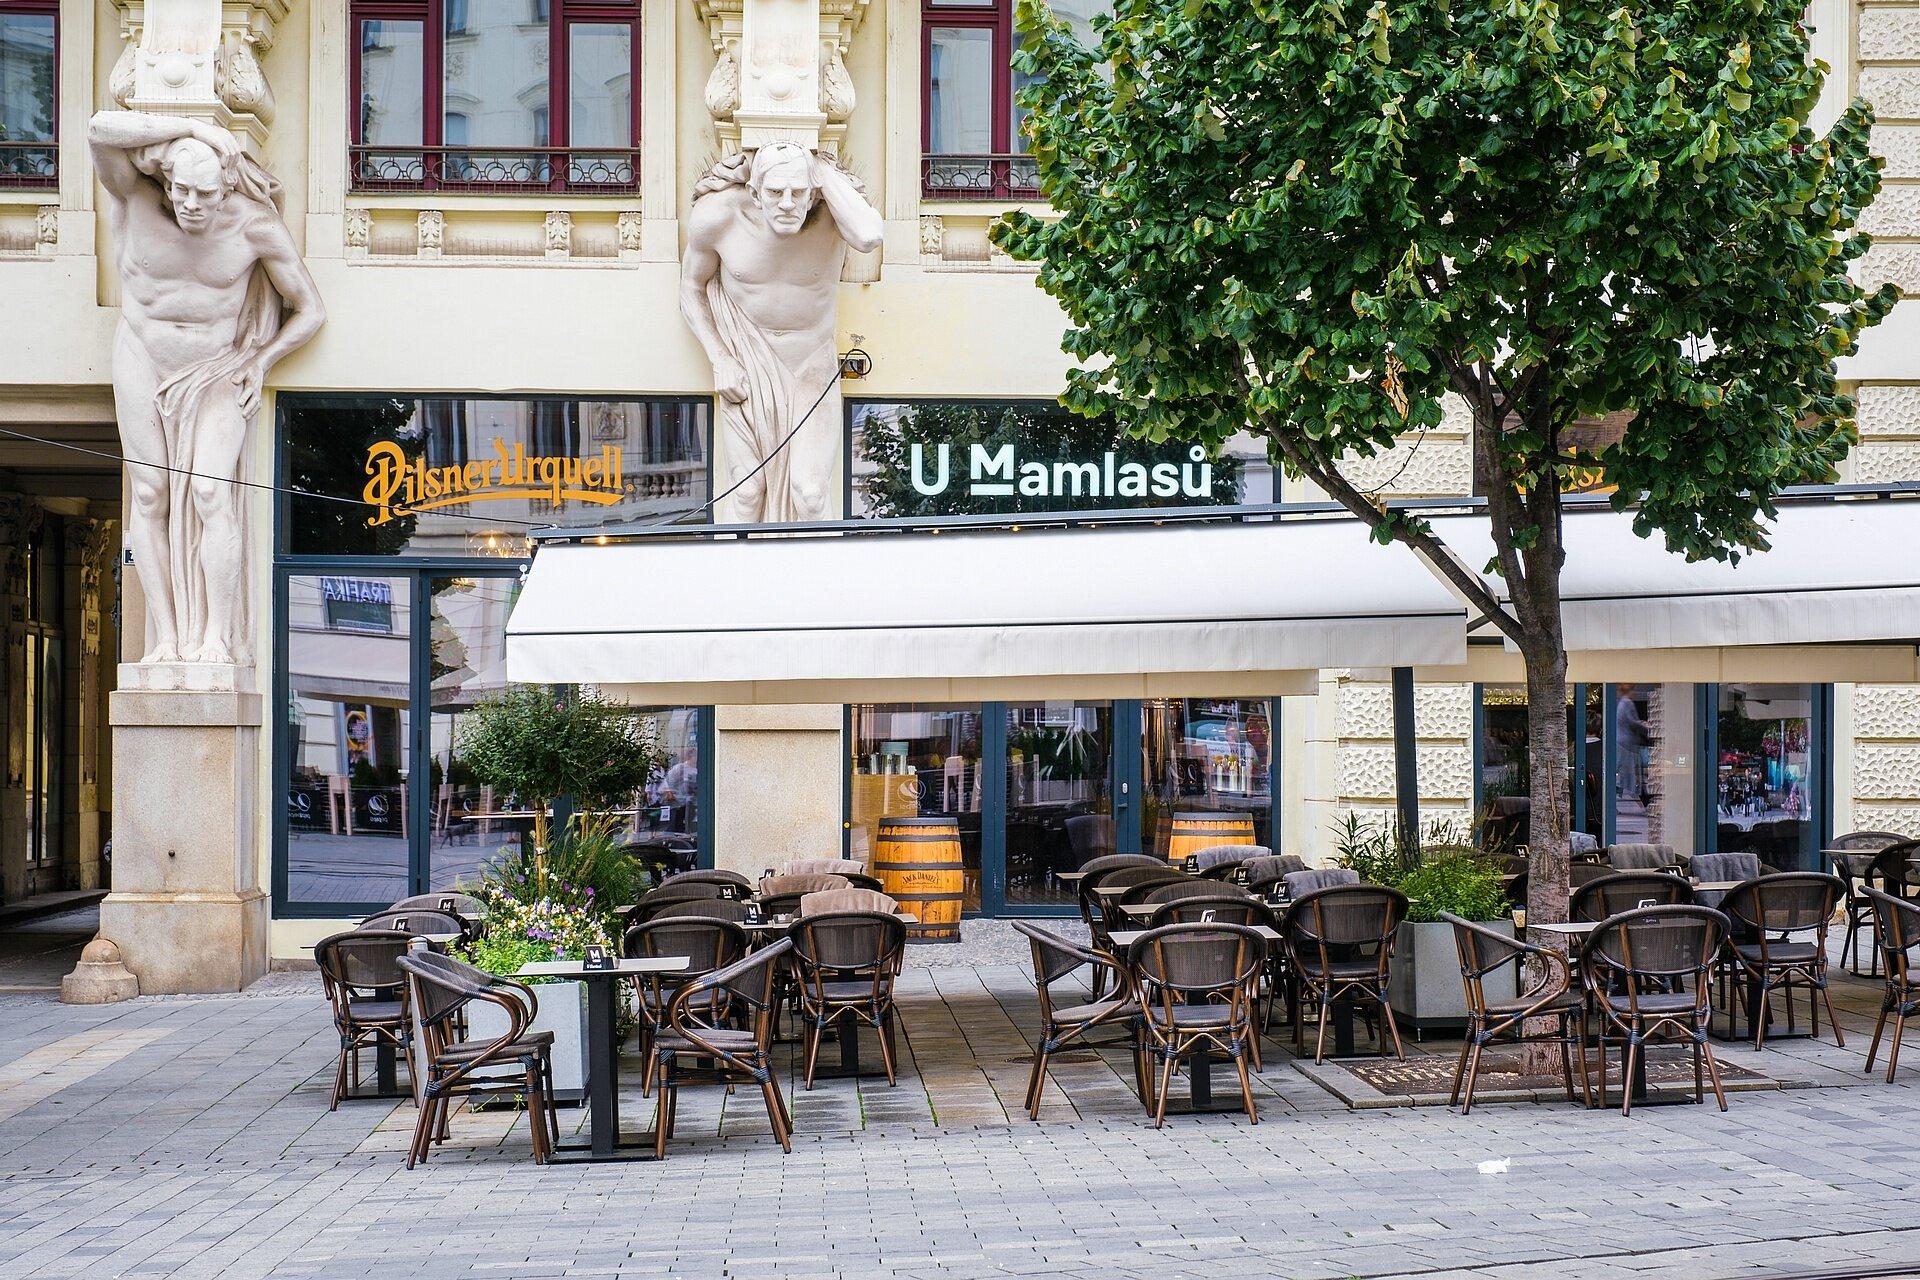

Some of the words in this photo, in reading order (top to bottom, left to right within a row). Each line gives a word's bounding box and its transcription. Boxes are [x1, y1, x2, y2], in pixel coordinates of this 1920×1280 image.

[911, 443, 949, 496] U
[970, 443, 1212, 498] Mamlasů
[363, 440, 499, 526] Pilsner
[495, 438, 624, 507] Urquell
[1238, 870, 1247, 881] M
[722, 888, 732, 899] M
[1277, 885, 1286, 897] M
[748, 907, 758, 919] M
[589, 949, 602, 963] M
